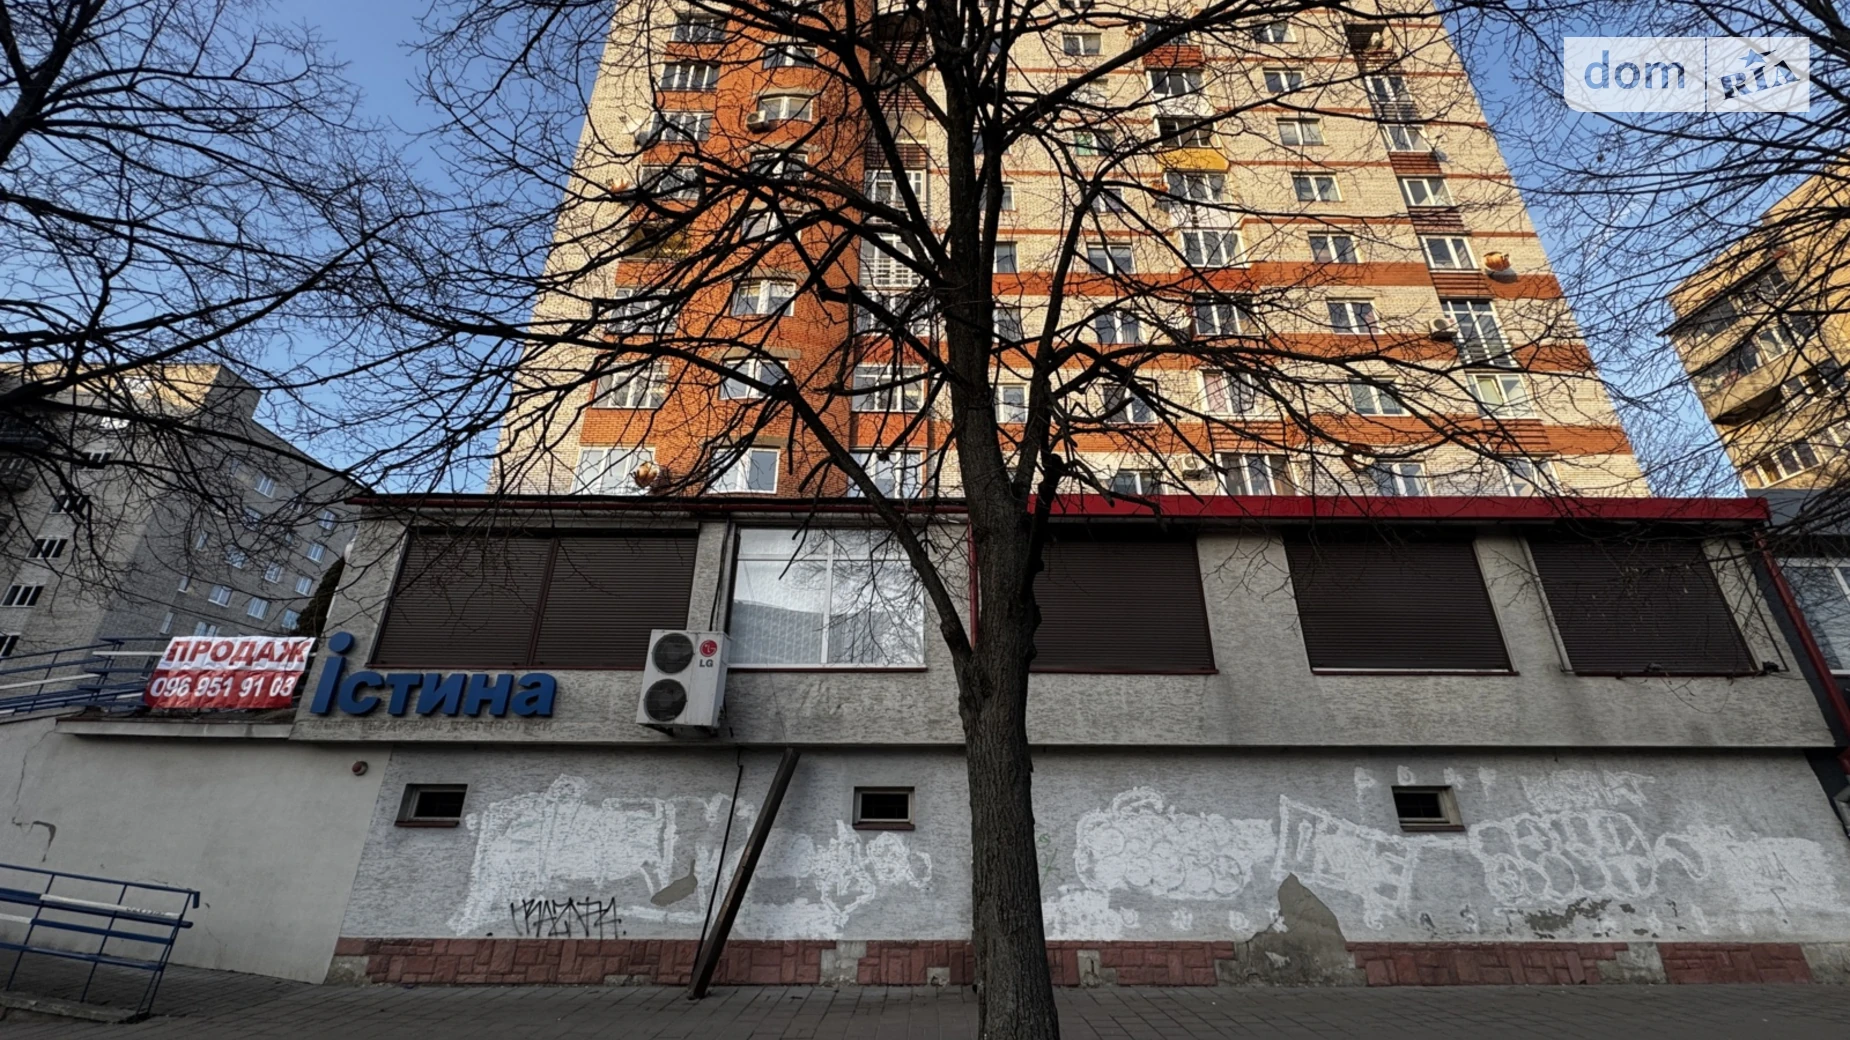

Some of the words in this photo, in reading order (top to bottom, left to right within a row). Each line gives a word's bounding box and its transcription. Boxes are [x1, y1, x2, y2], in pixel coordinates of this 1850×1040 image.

[166, 640, 310, 666] ПРОДАЖ
[699, 658, 714, 668] LG
[310, 631, 557, 718] істина
[150, 676, 191, 697] 096
[194, 676, 233, 697] 951
[239, 676, 262, 697] 91
[269, 676, 296, 697] 03
